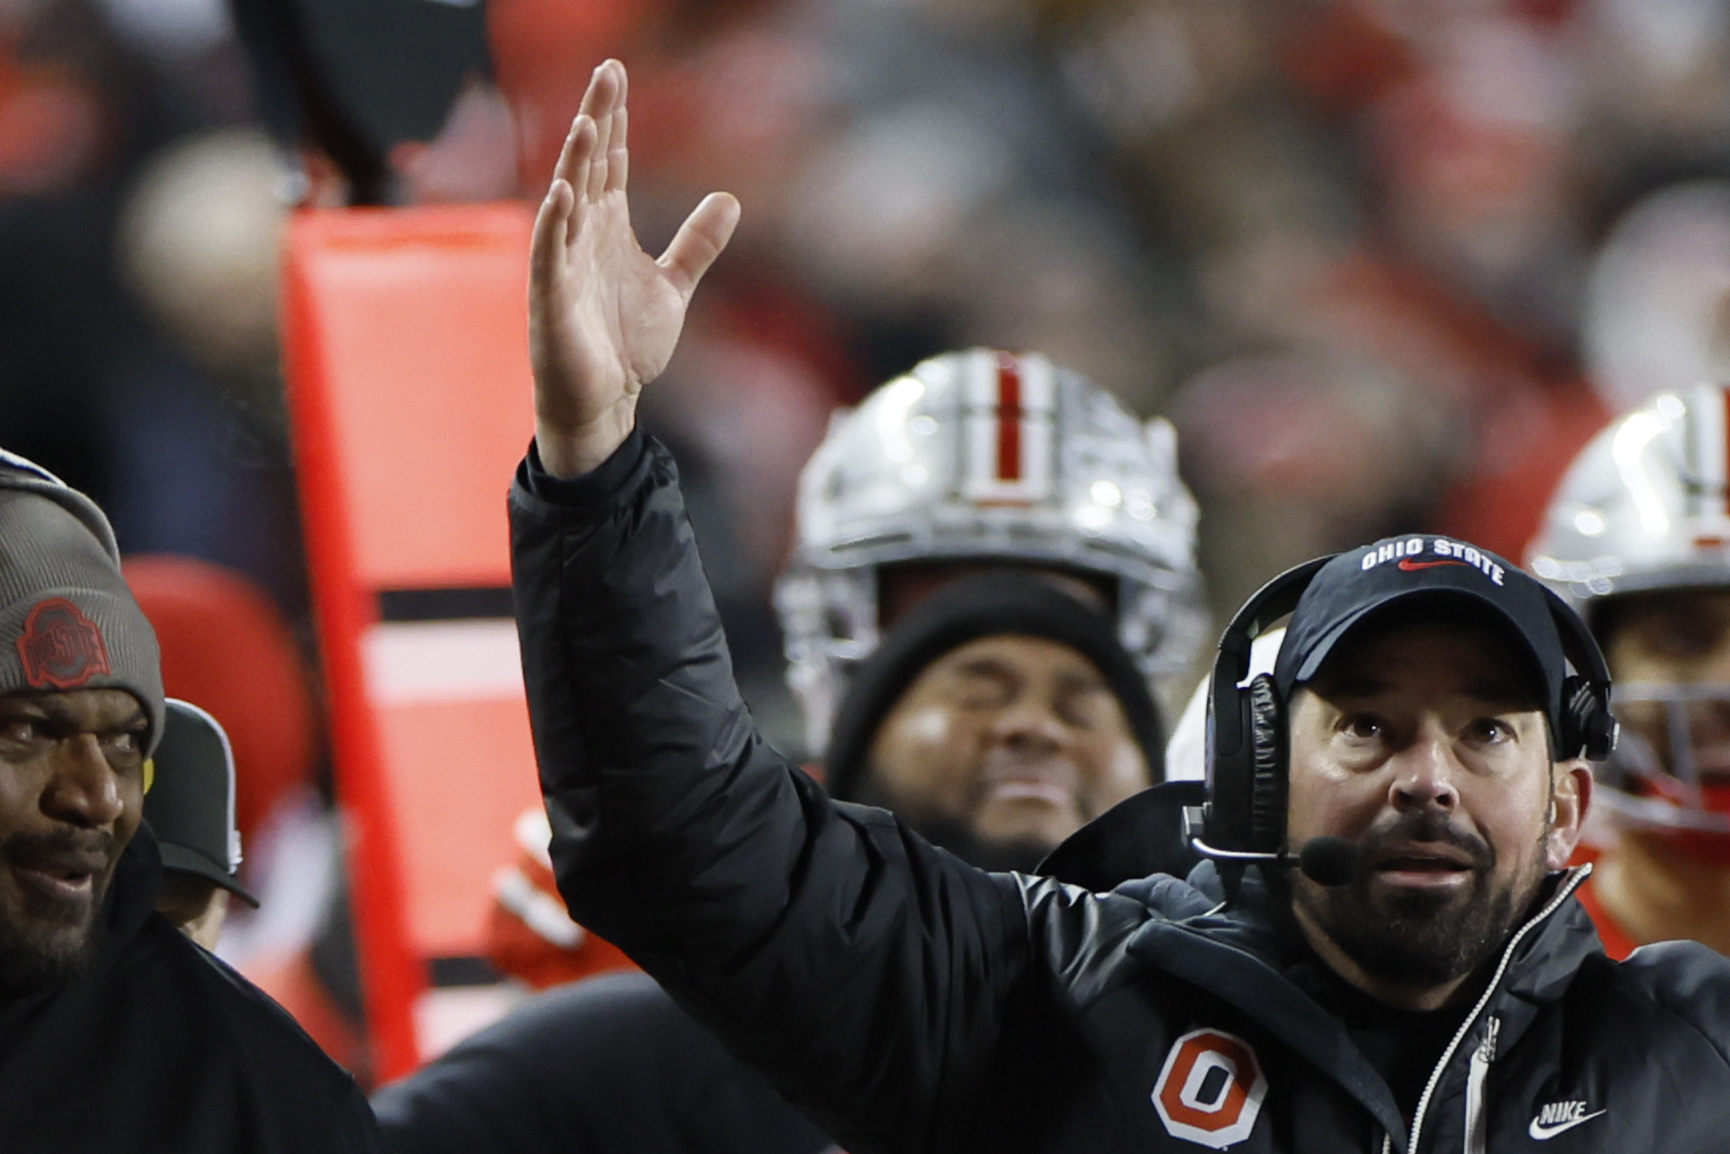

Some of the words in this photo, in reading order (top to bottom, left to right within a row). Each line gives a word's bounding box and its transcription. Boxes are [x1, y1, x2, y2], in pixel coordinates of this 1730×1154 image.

[1361, 537, 1424, 571] OHIO
[1433, 538, 1505, 586] STATE
[1151, 1027, 1268, 1149] O
[1539, 1101, 1587, 1125] NIKE
